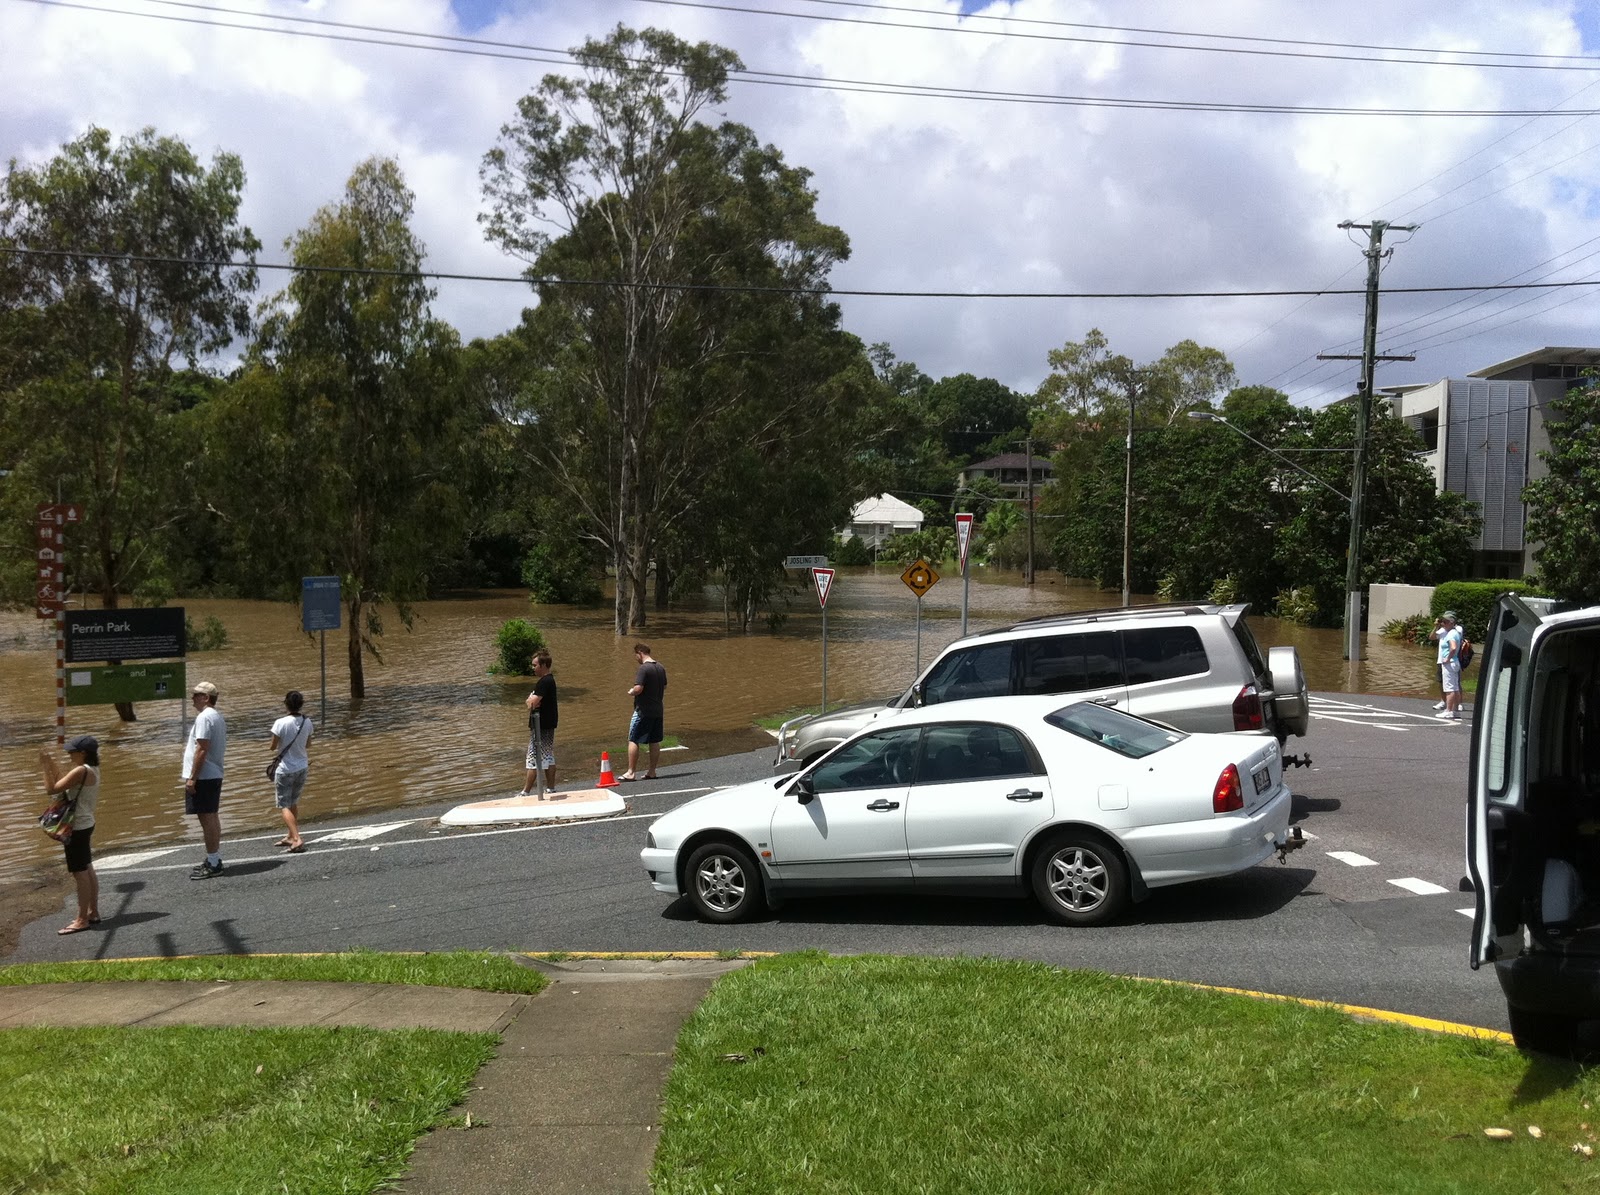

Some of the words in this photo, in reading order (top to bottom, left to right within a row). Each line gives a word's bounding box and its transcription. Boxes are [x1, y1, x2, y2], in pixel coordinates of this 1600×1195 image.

[789, 556, 812, 565] JOSLING
[72, 623, 103, 634] Perrin
[107, 621, 131, 632] Park
[130, 669, 146, 677] and
